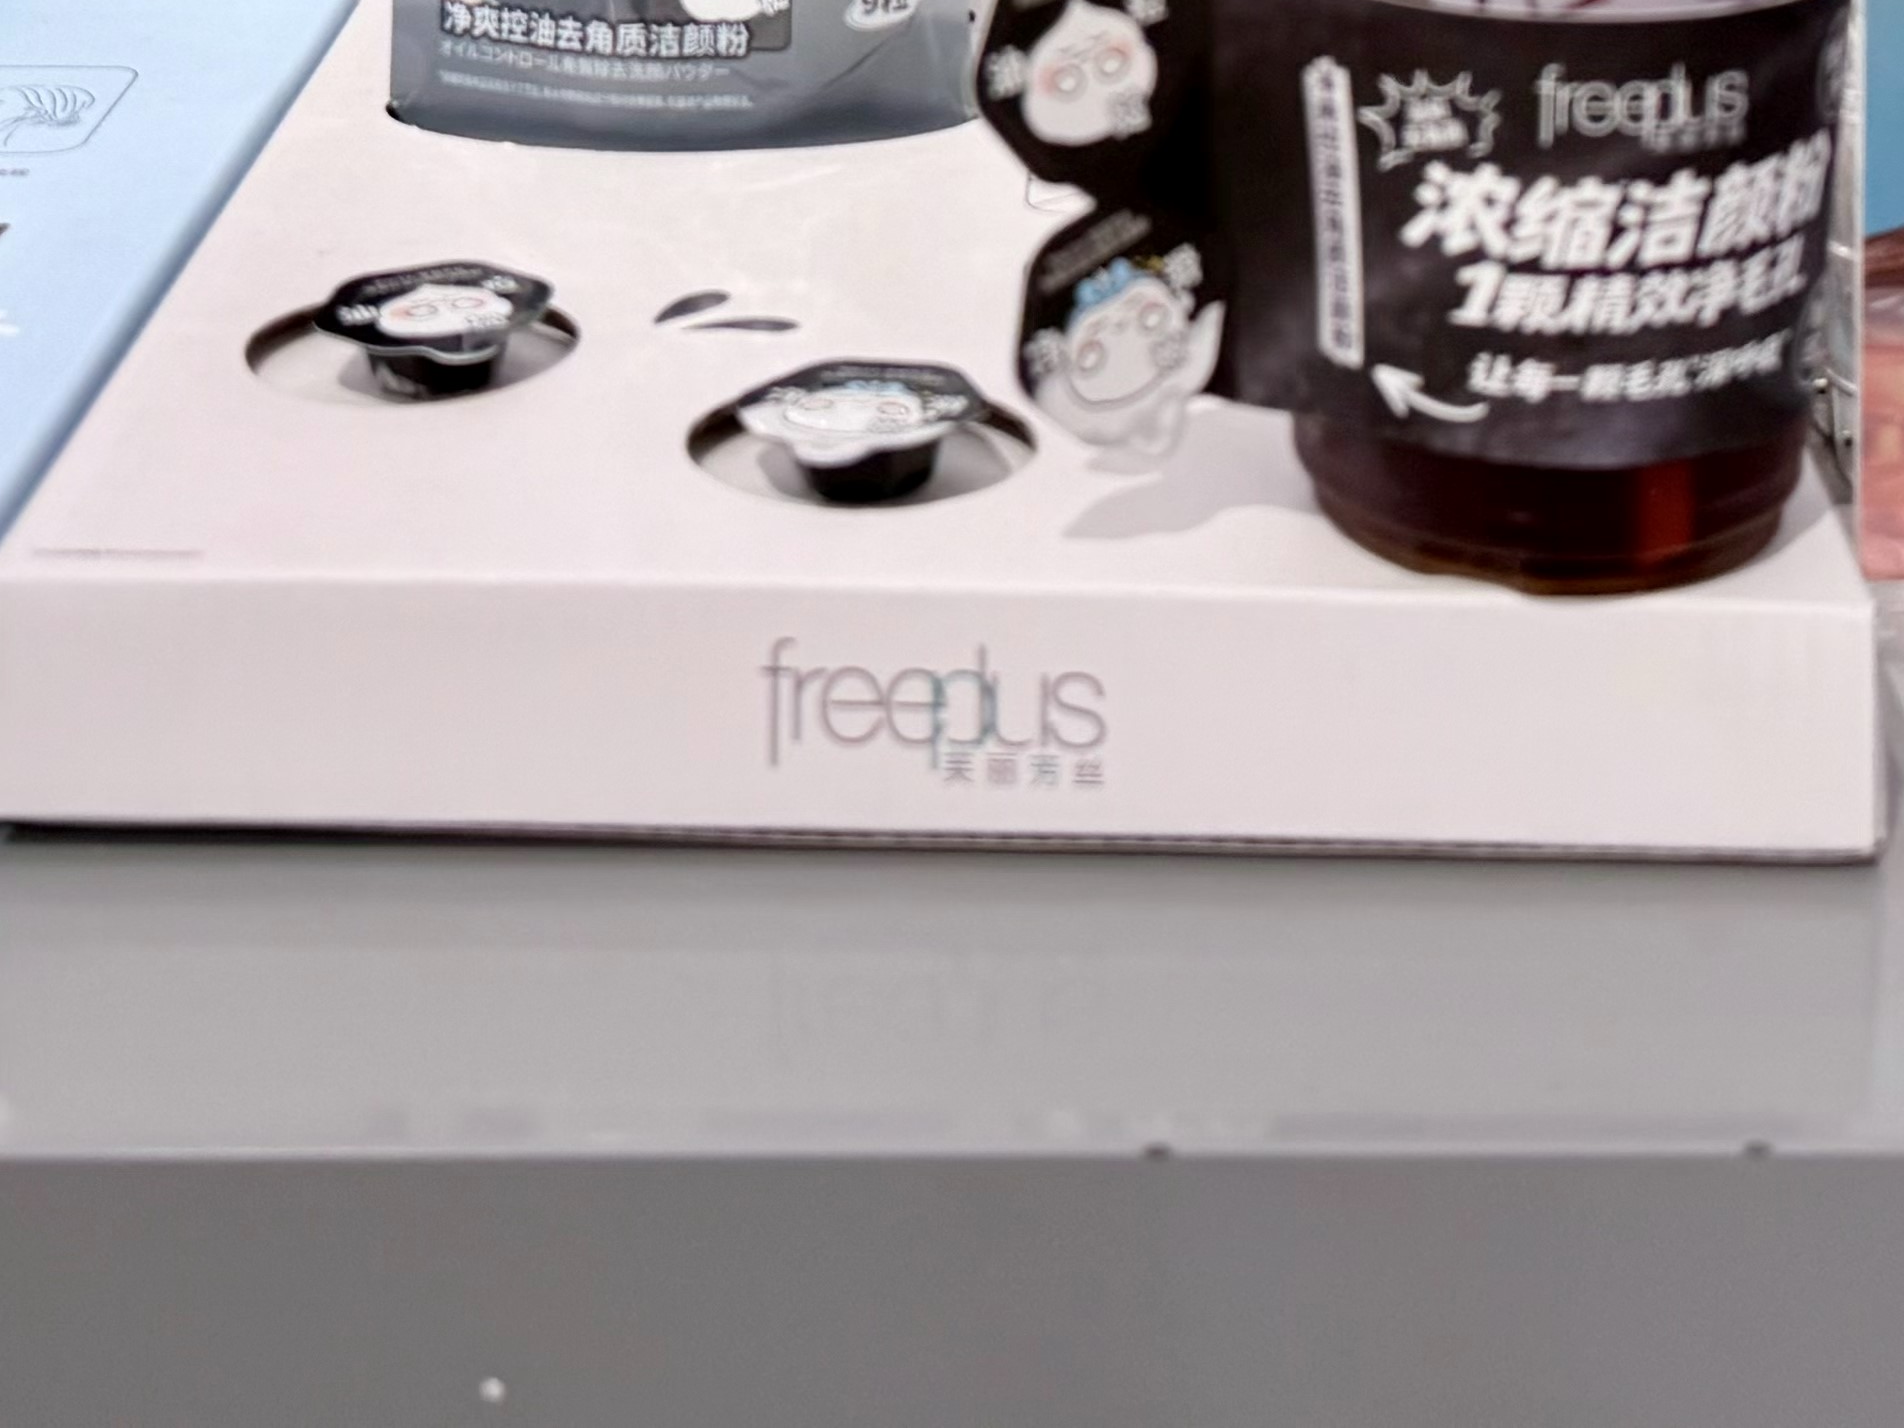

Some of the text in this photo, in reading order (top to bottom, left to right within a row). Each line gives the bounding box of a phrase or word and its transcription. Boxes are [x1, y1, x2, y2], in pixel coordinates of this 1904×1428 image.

[445, 1, 749, 58] 净爽控油去角质洁颜粉
[1536, 63, 1749, 147] freeplus
[1399, 128, 1831, 270] 浓缩洁颜粉
[759, 636, 1107, 771] freeplus
